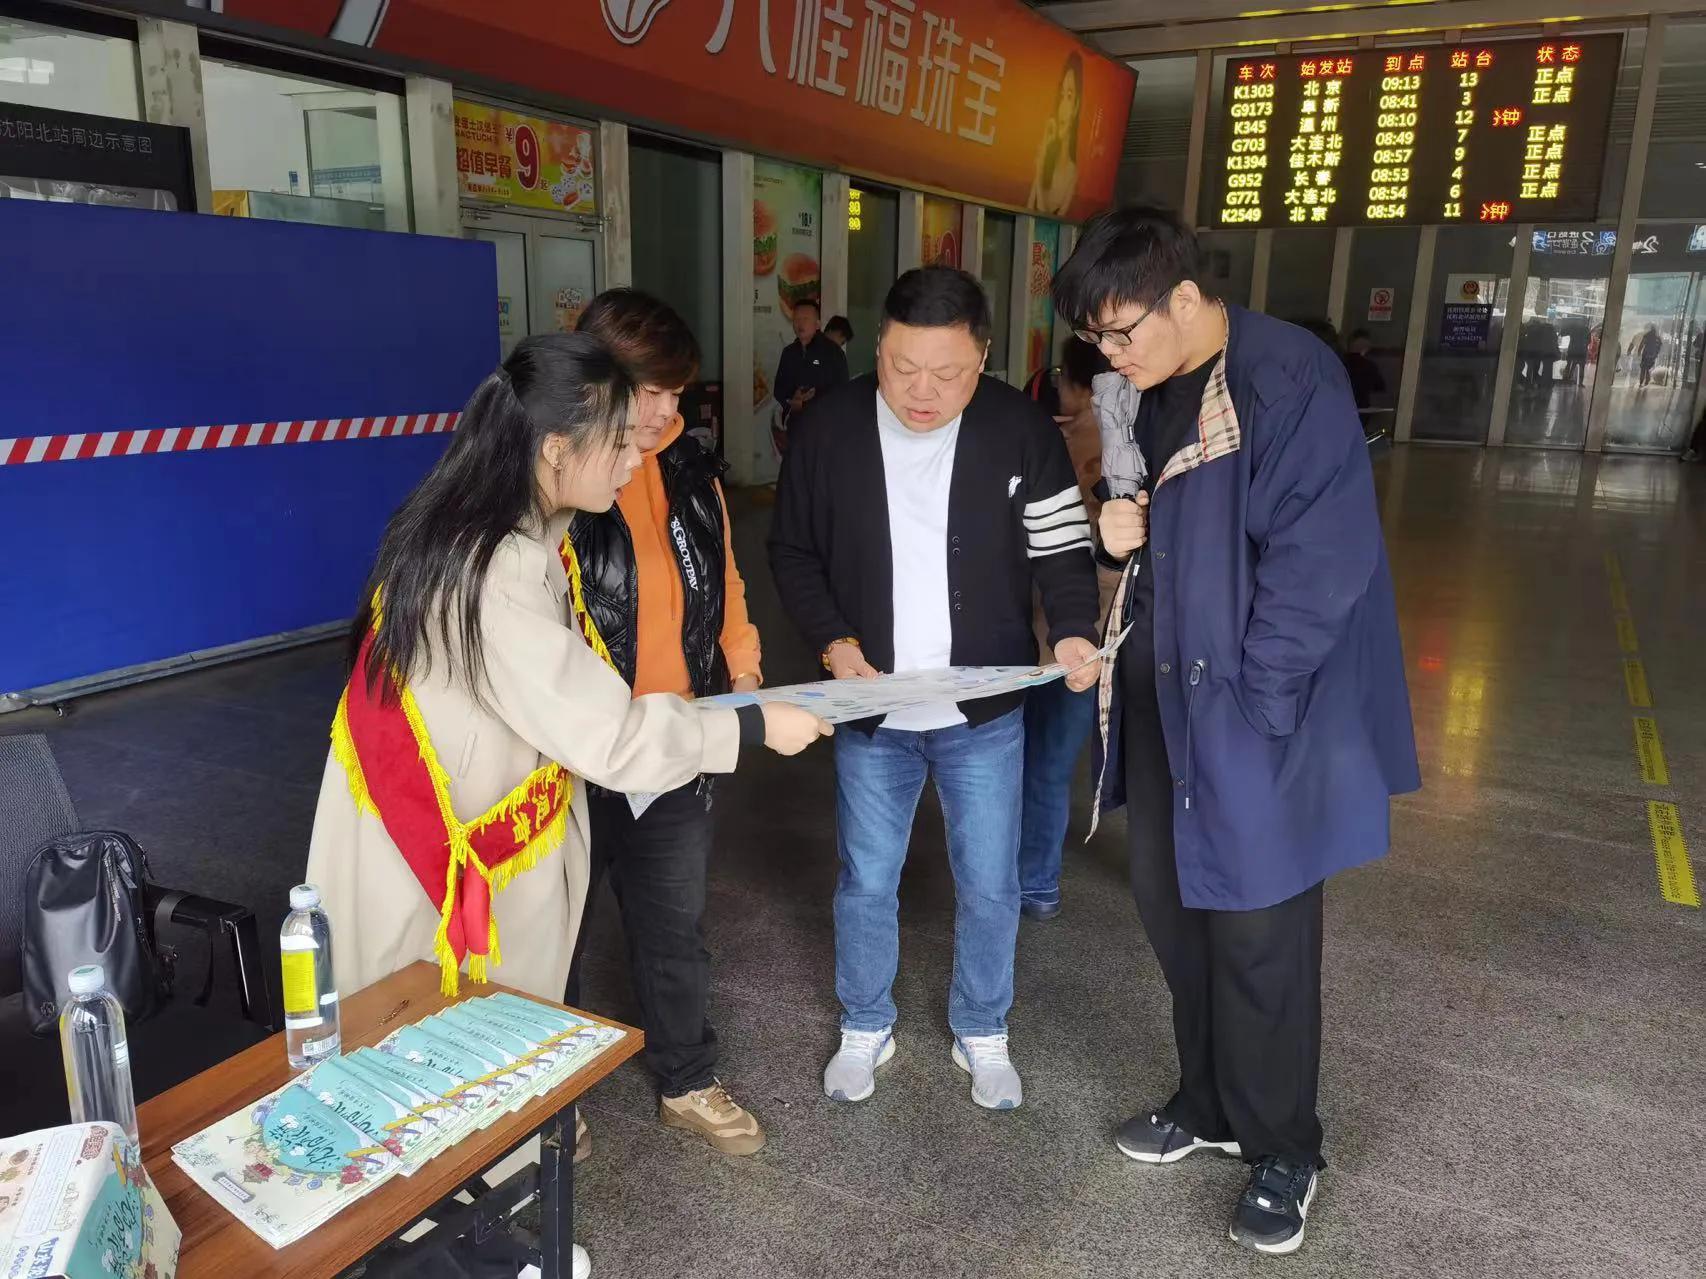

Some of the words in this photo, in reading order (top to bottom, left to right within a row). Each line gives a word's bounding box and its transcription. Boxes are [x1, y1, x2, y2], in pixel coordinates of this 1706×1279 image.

[1239, 64, 1274, 79] 车次
[1301, 59, 1352, 76] 始发站
[1385, 54, 1424, 71] 到点
[1451, 51, 1493, 68] 站台
[1537, 46, 1580, 63] 状态
[1233, 84, 1274, 99] K1303
[1304, 80, 1342, 96] 北京
[1382, 76, 1420, 90] 09:13
[1459, 73, 1479, 87] 13
[1535, 67, 1575, 84] 正点
[1231, 102, 1272, 117] G9173
[1380, 94, 1418, 109] 08:41
[1462, 92, 1472, 106] 3
[1532, 87, 1572, 103] 正点
[0, 119, 152, 153] 沈阳北站周边示意图
[1234, 120, 1267, 134] K345
[1378, 113, 1416, 127] 08:10
[1455, 110, 1474, 125] 12
[1232, 138, 1266, 153] G703
[1290, 134, 1343, 150] 大连北
[1375, 131, 1415, 145] 08:49
[1457, 129, 1468, 143] 7
[1527, 124, 1567, 141] 正点
[456, 146, 511, 177] 超值早餐
[1227, 155, 1267, 170] K1394
[1289, 152, 1341, 168] 佳木斯
[1373, 149, 1413, 164] 08:57
[1455, 147, 1465, 161] 9
[1525, 143, 1564, 160] 正点
[1228, 173, 1262, 188] G952
[1294, 170, 1331, 187] 长春
[1371, 168, 1409, 182] 08:53
[1452, 166, 1463, 180] 4
[1522, 163, 1561, 179] 正点
[1226, 191, 1260, 206] G771
[1284, 189, 1337, 205] 大连北
[1369, 186, 1408, 201] 08:54
[1450, 184, 1461, 199] 6
[1520, 182, 1559, 198] 正点
[1222, 208, 1262, 223] K2549
[1290, 207, 1328, 222] 北京
[1366, 204, 1406, 219] 08:54
[1444, 203, 1462, 217] 11
